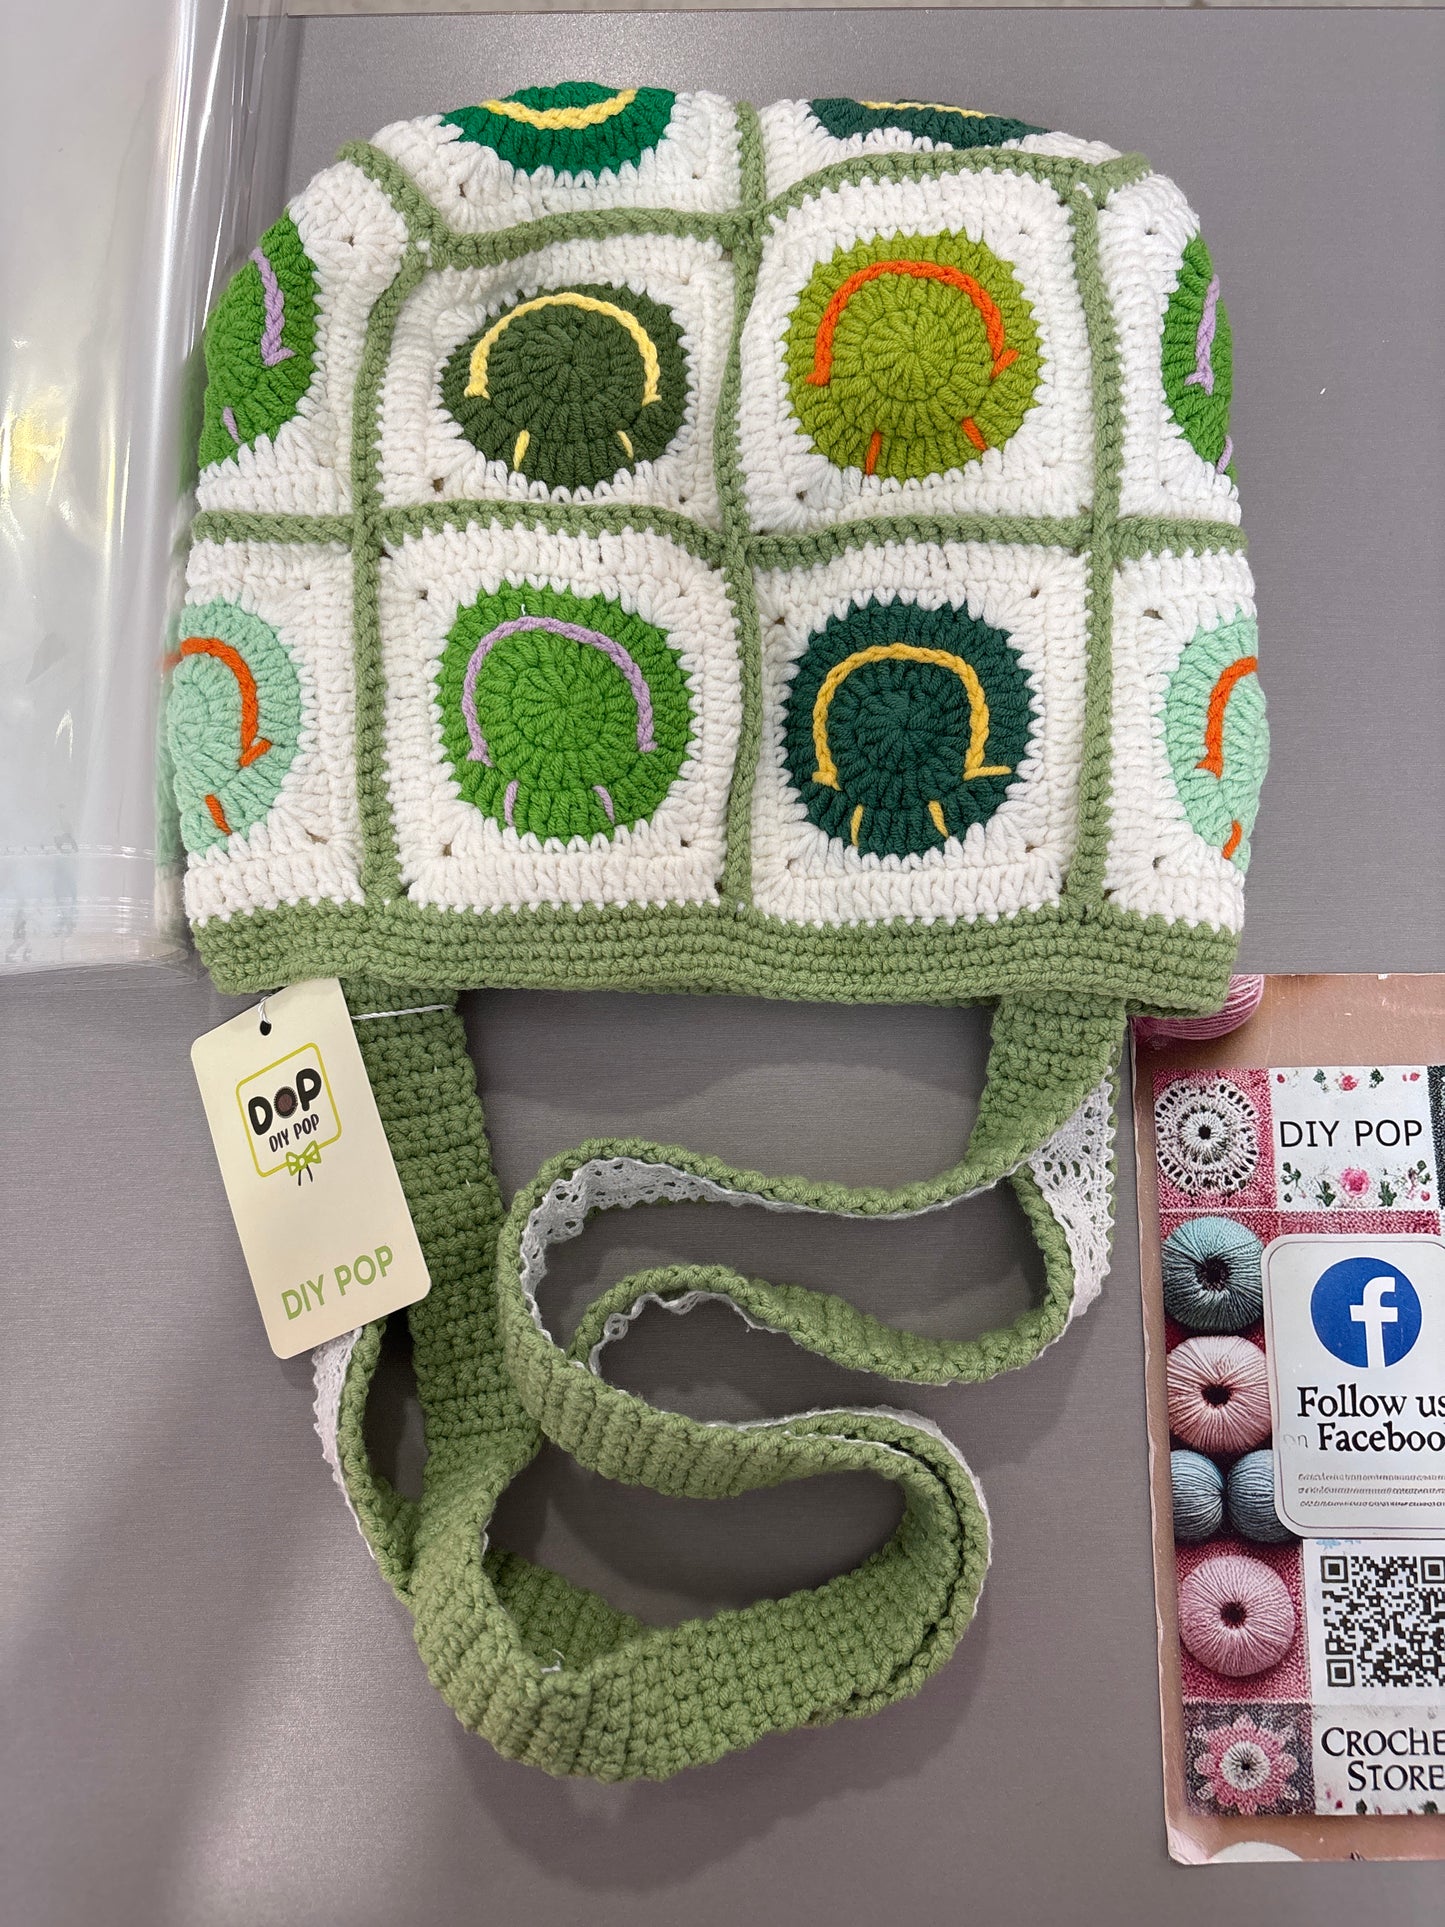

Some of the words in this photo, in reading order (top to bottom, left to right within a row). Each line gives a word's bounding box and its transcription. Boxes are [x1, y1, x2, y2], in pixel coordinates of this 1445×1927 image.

[268, 1128, 290, 1153] DIY
[293, 1113, 320, 1141] POP
[1279, 1120, 1341, 1148] DIY
[1354, 1119, 1423, 1147] POP
[281, 1274, 325, 1321] DIY
[333, 1245, 394, 1297] POP
[1296, 1383, 1408, 1418] Follow
[1415, 1395, 1445, 1418] us
[1317, 1420, 1445, 1452] Faceboo
[1347, 1760, 1445, 1792] STORE
